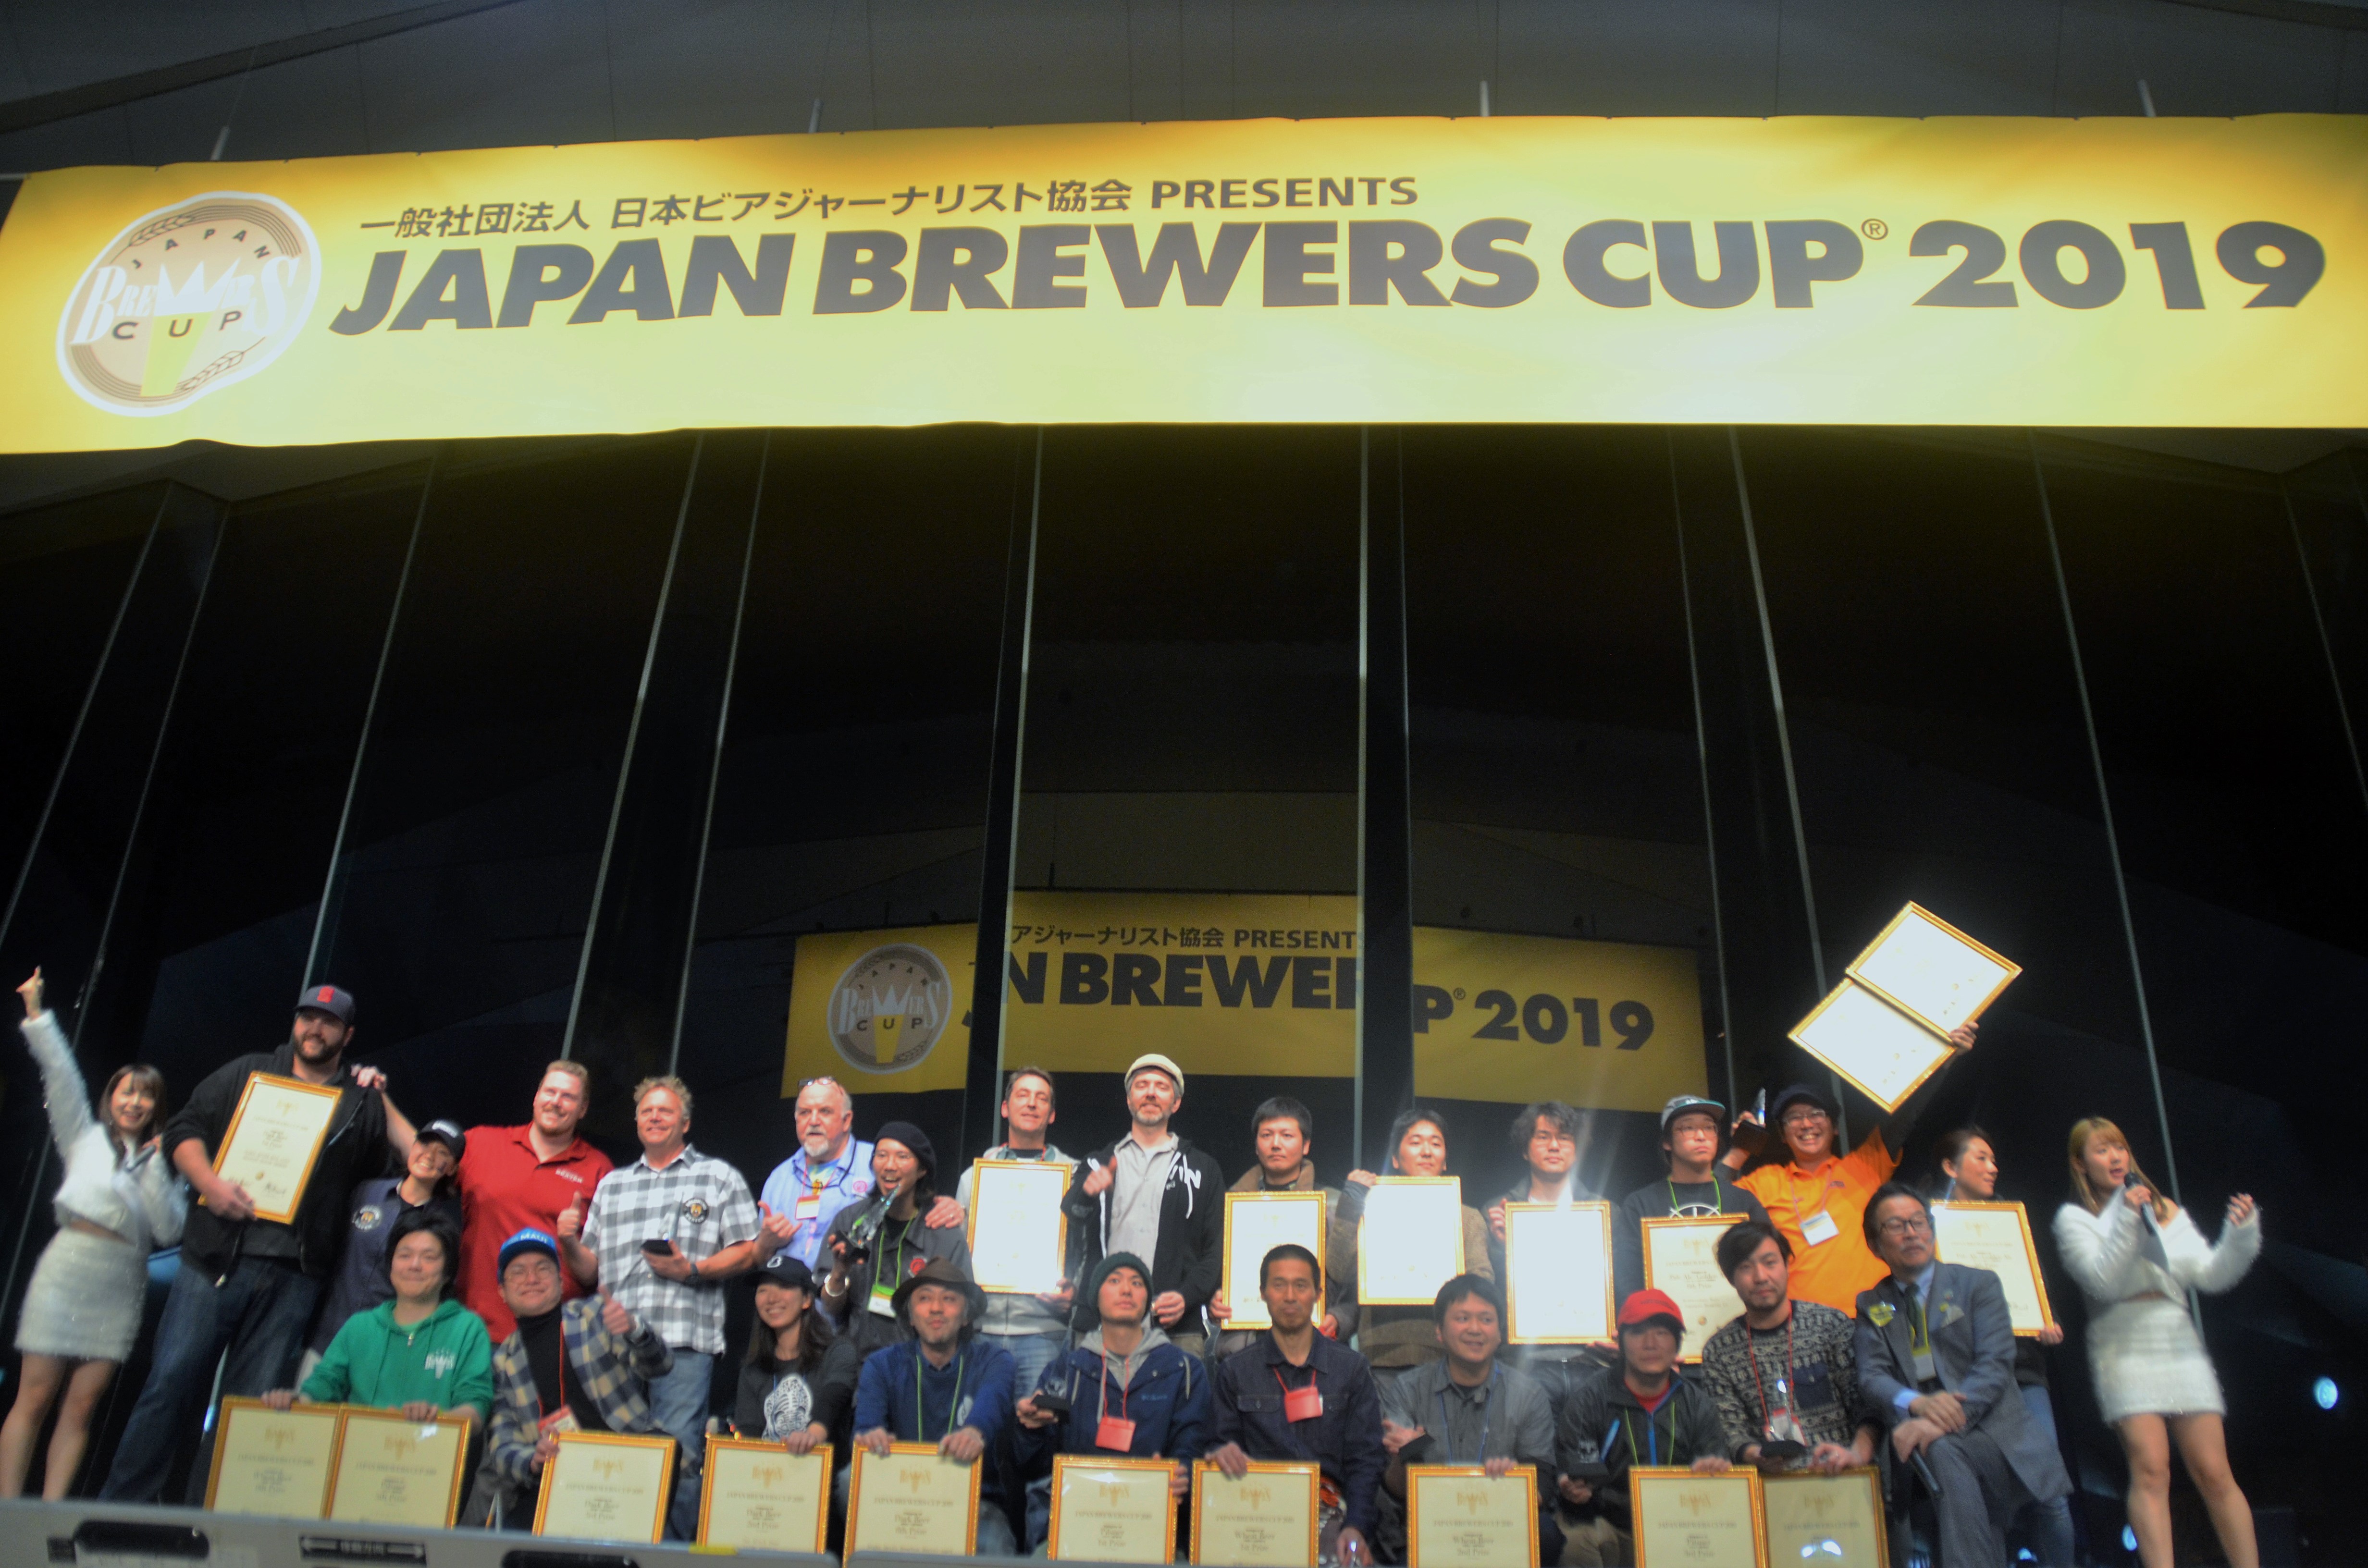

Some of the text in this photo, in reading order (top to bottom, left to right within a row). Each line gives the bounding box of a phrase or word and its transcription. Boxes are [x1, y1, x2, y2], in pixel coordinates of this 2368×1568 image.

[360, 177, 1418, 238] 一般社団法人 日本ビアジャーナリスト協会 PRESENTS
[132, 228, 271, 270] JAPAN
[329, 233, 796, 336] JAPAN
[813, 217, 1540, 315] BREWERS
[1910, 219, 2327, 310] 2019
[112, 310, 242, 340] CUP
[1011, 924, 1362, 950] アジャーナリスト協会 PRESENT
[1059, 952, 1363, 1010] BREWE
[856, 1017, 923, 1031] CUP
[1470, 988, 1655, 1052] 2019
